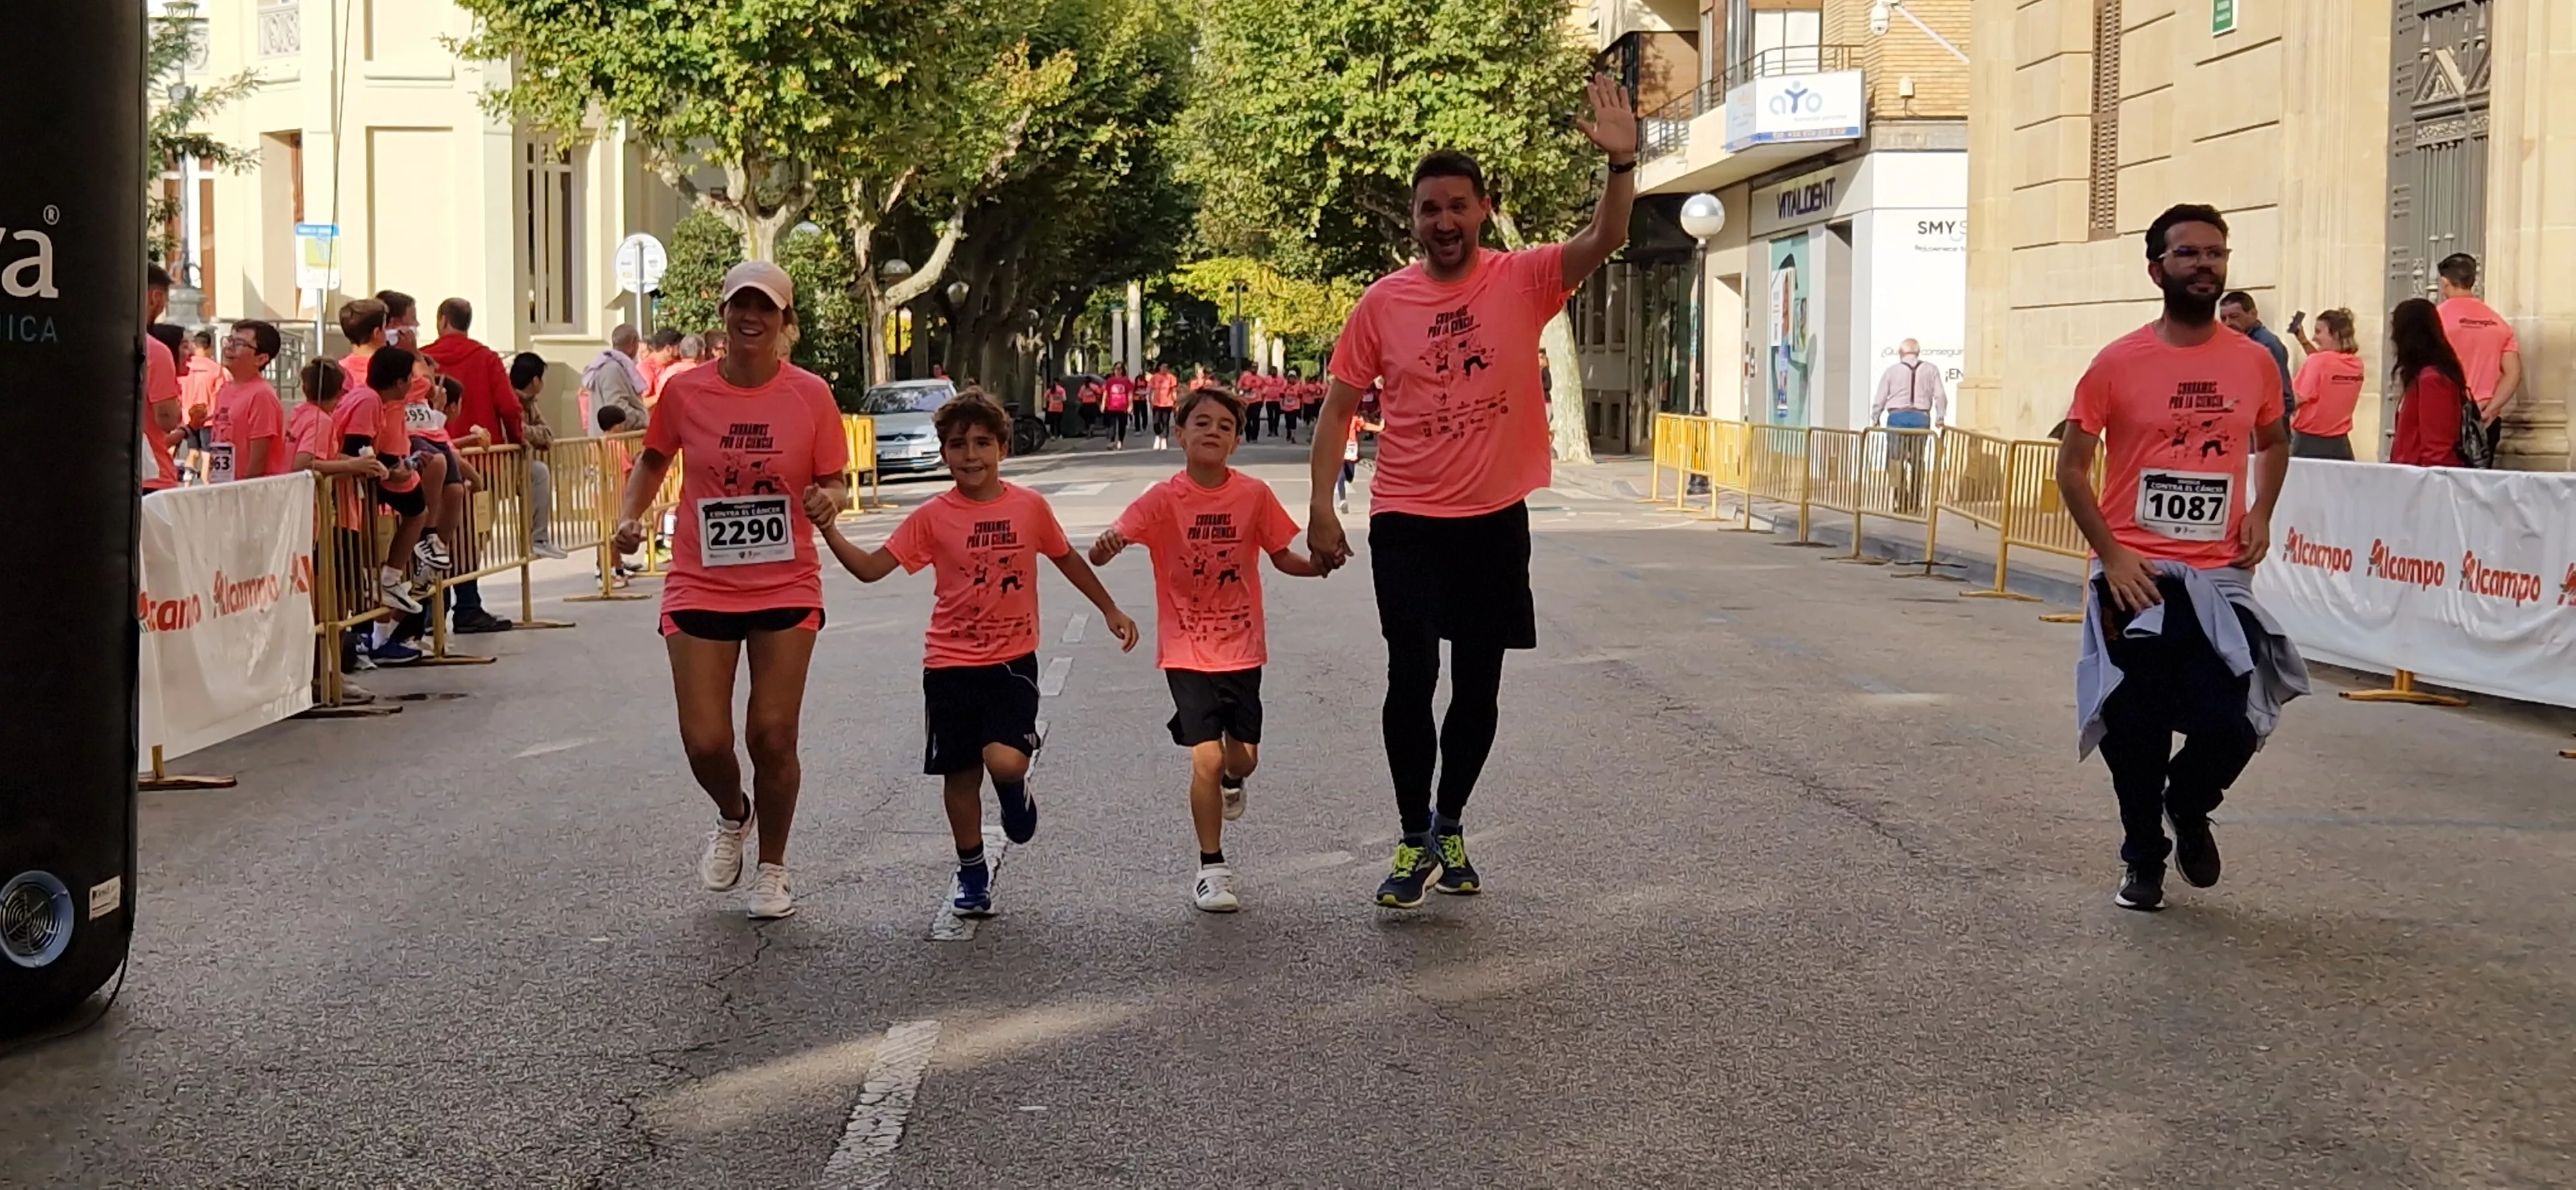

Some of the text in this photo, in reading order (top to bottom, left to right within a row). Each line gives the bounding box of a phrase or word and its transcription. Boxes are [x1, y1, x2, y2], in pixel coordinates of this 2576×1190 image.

[1776, 177, 1835, 219] VITALDENT
[0, 314, 57, 343] ICA
[2169, 395, 2224, 409] POR LA CIENCIA
[2177, 382, 2217, 395] CORRAMOS
[214, 456, 230, 470] 63
[2150, 494, 2223, 521] 1087
[710, 517, 784, 545] 2290
[2283, 526, 2353, 576] Alcampo
[2367, 538, 2445, 591] Alcampo
[2459, 550, 2541, 607] Alcampo
